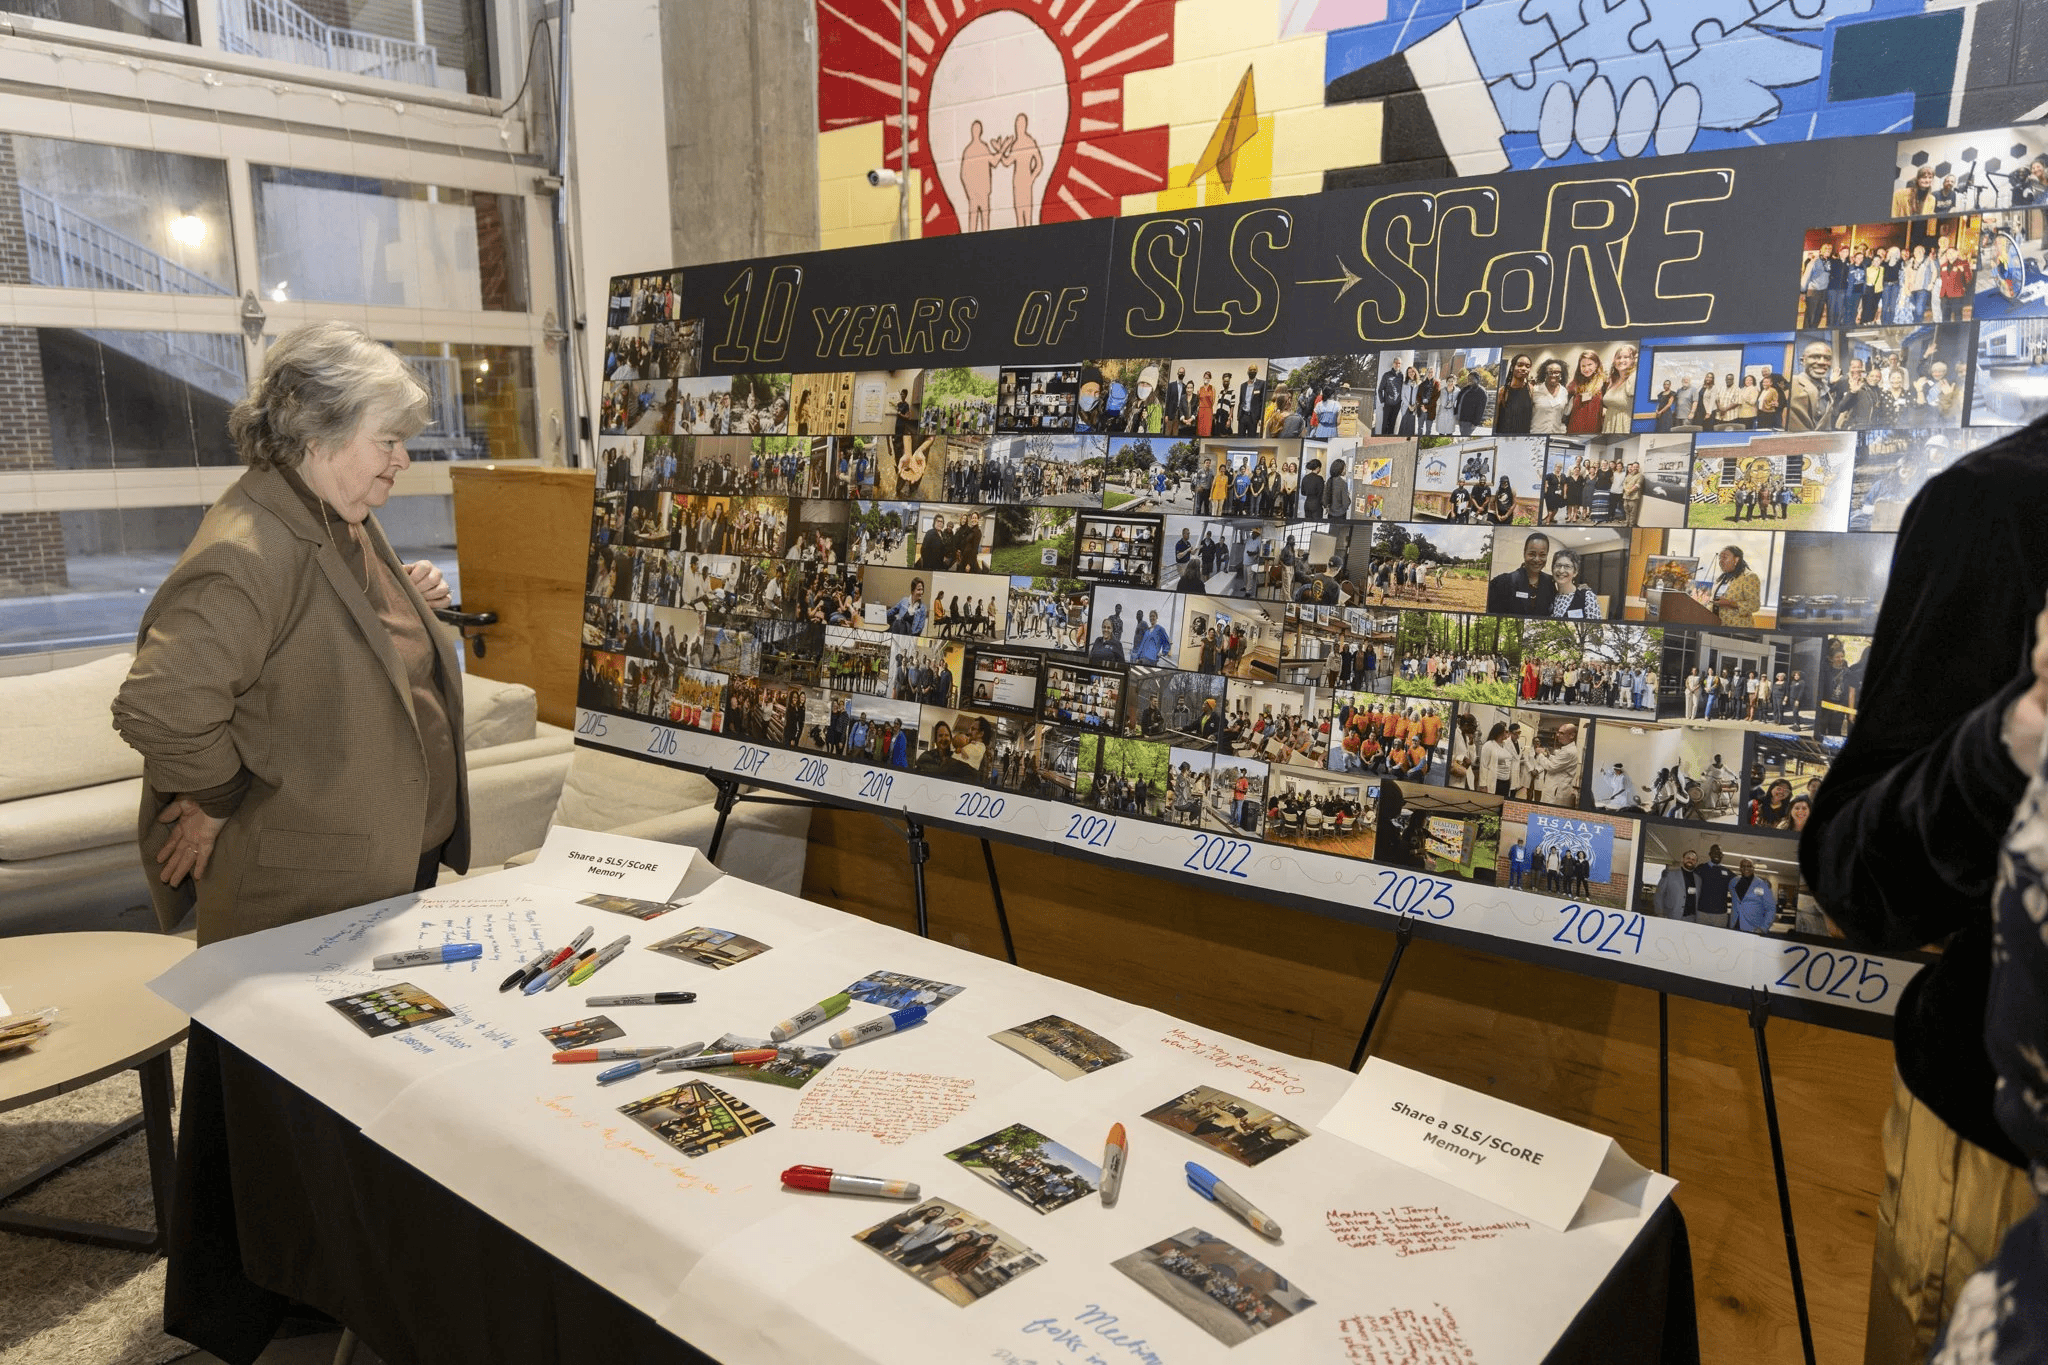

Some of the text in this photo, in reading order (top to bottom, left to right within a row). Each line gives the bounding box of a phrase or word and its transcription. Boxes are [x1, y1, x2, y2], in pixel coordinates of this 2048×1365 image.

[713, 266, 803, 362] 10
[812, 297, 979, 357] YEARS
[1014, 287, 1088, 346] OF
[1125, 207, 1293, 338] SLS
[568, 850, 595, 862] Share
[605, 856, 658, 872] SLS/SCoRE
[577, 711, 1889, 1004] 2015 2016 2017 2018 2019 2020 2021 2022 2023 2024 2025
[588, 865, 626, 879] Memory
[1391, 1101, 1544, 1165] Share a SLS/SCoRE
[1423, 1132, 1487, 1165] Memory
[1074, 1303, 1163, 1365] Meetin
